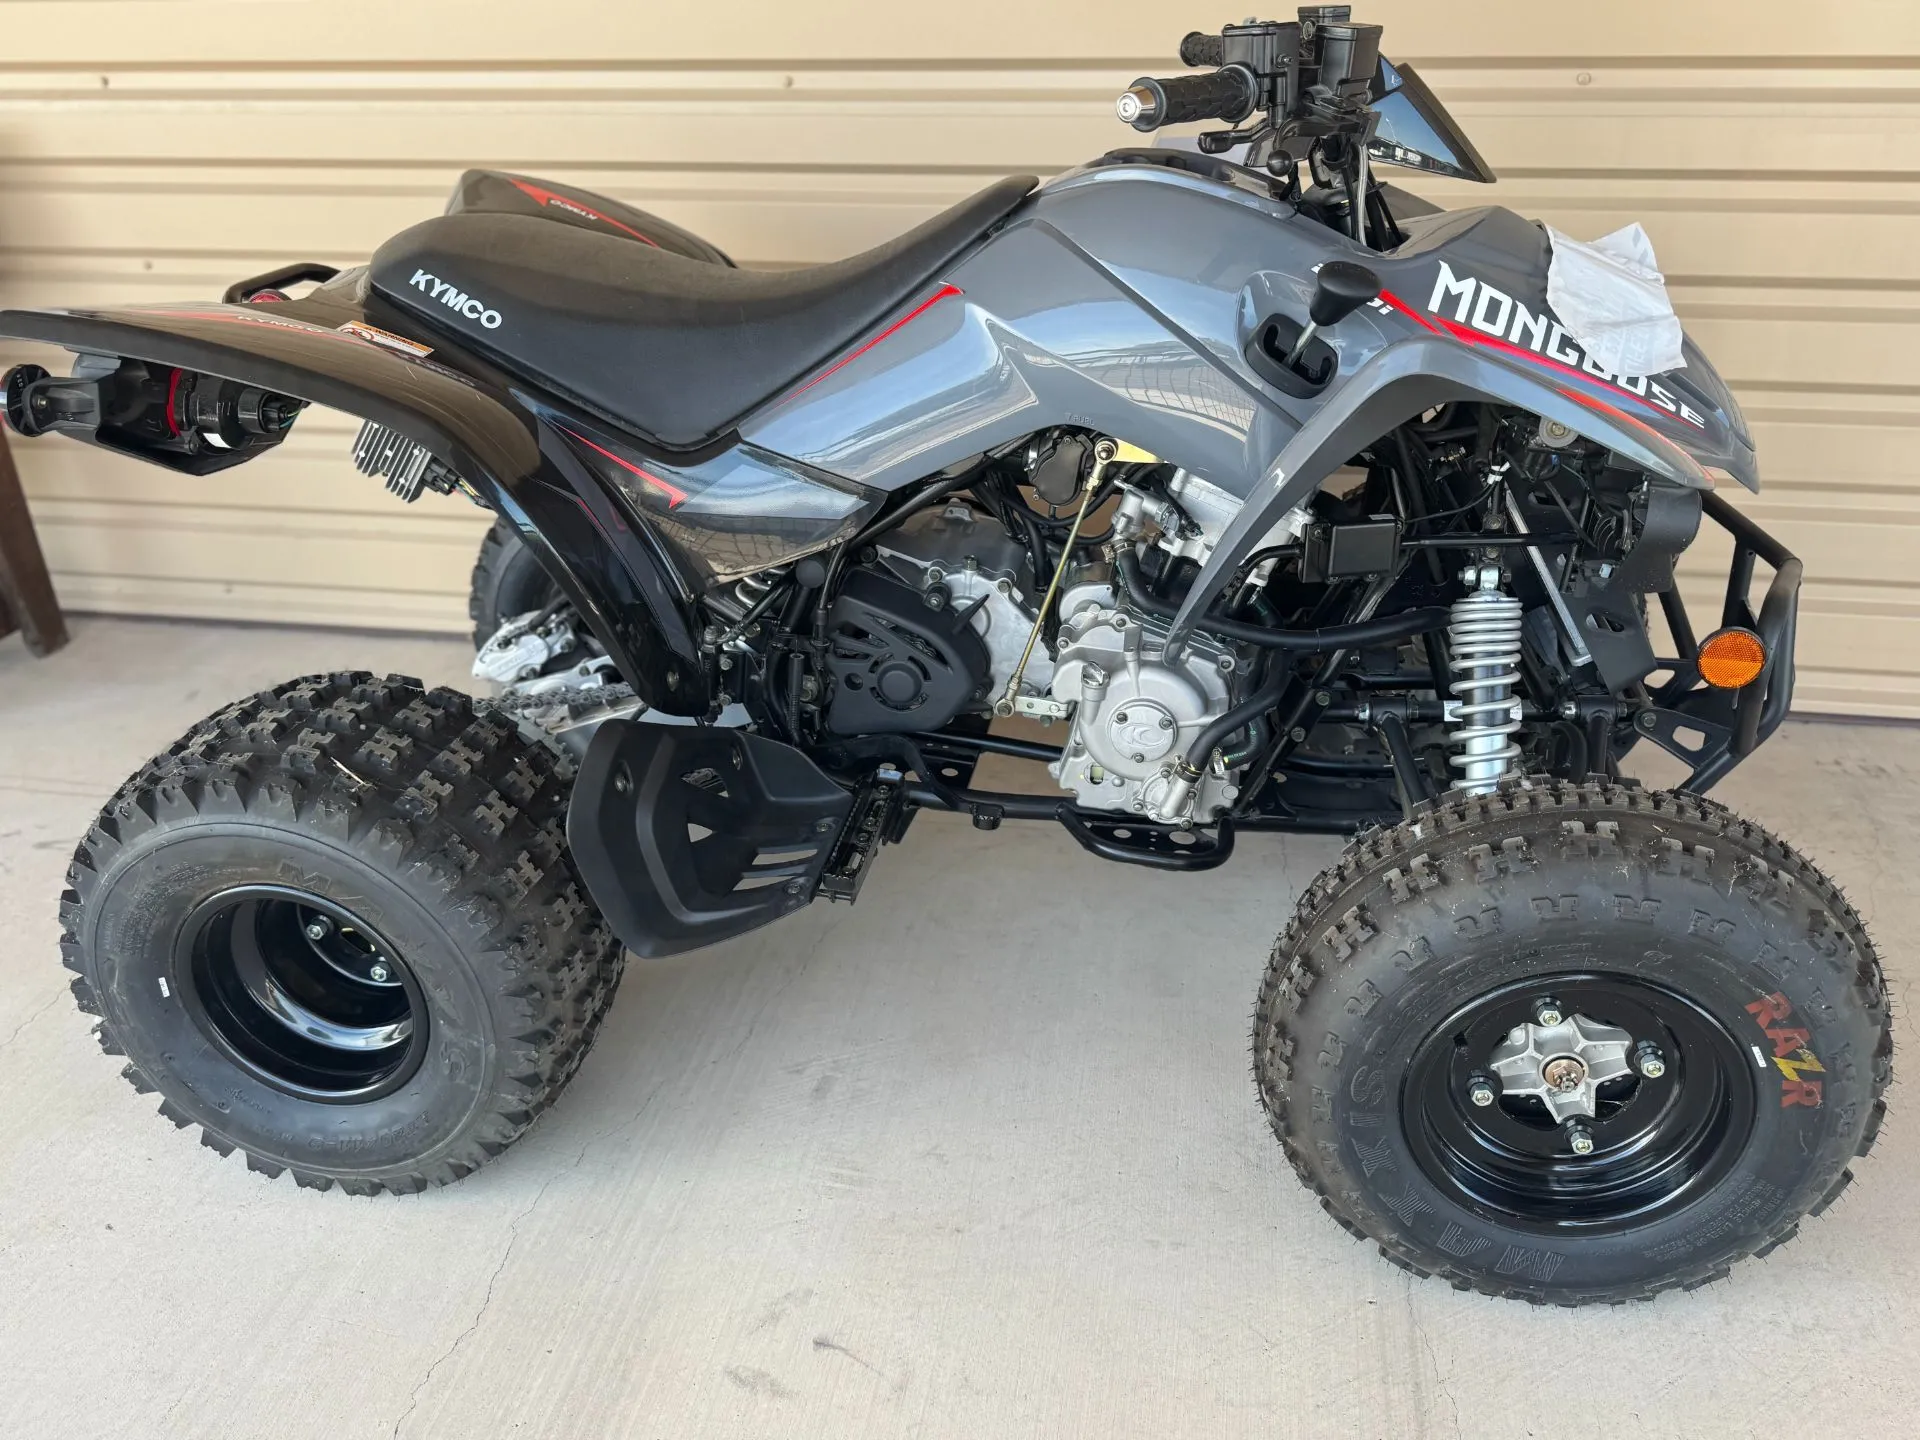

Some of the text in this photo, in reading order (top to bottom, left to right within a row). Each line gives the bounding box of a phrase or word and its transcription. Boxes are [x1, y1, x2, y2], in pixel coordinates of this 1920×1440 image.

[409, 268, 502, 329] KYMCO
[1745, 992, 1826, 1108] RAZR
[1350, 1066, 1566, 1281] MAXXIS
